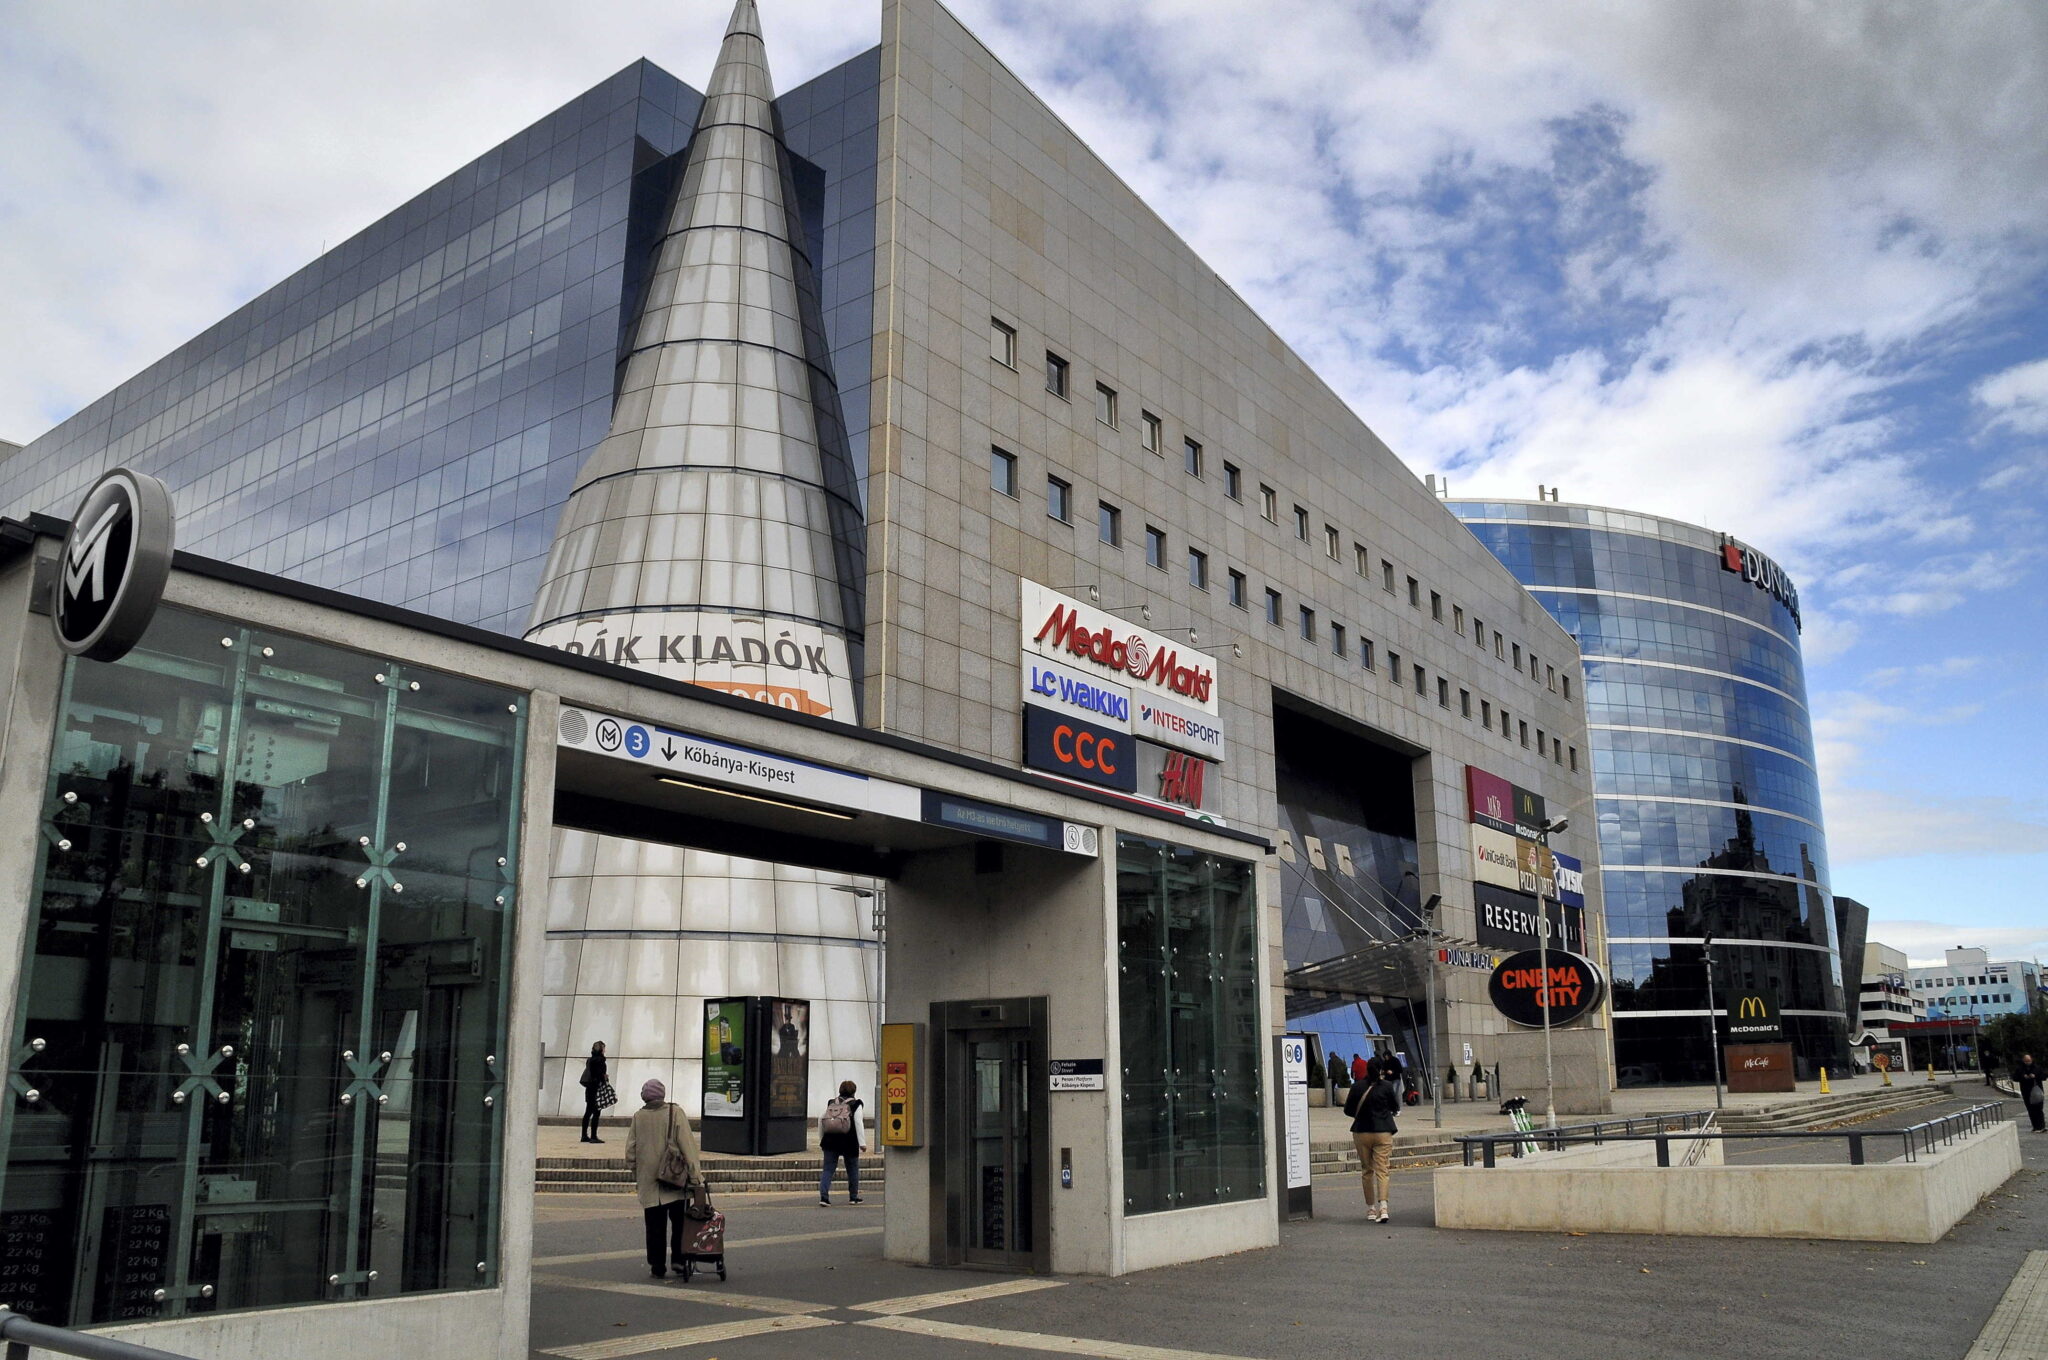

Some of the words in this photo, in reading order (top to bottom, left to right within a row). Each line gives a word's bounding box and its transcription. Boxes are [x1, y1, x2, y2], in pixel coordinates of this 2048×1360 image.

[658, 630, 834, 677] KIADÓK
[1034, 603, 1127, 671] Media
[1146, 645, 1213, 703] Markt
[1031, 666, 1057, 697] LC
[1152, 708, 1220, 746] INTERSPORT
[632, 732, 643, 751] 3
[684, 745, 795, 784] Kőbánya-Kispest
[1053, 725, 1116, 775] CCC
[1485, 847, 1505, 867] UniCredit
[1505, 854, 1518, 869] Bank
[1520, 870, 1537, 893] PIZZA
[1559, 867, 1584, 895] JYSK
[1447, 949, 1471, 967] DUNA
[1473, 952, 1494, 970] PLAZA
[1535, 986, 1582, 1008] CITY
[1730, 1025, 1779, 1033] McDonald's
[888, 1087, 906, 1097] SOS
